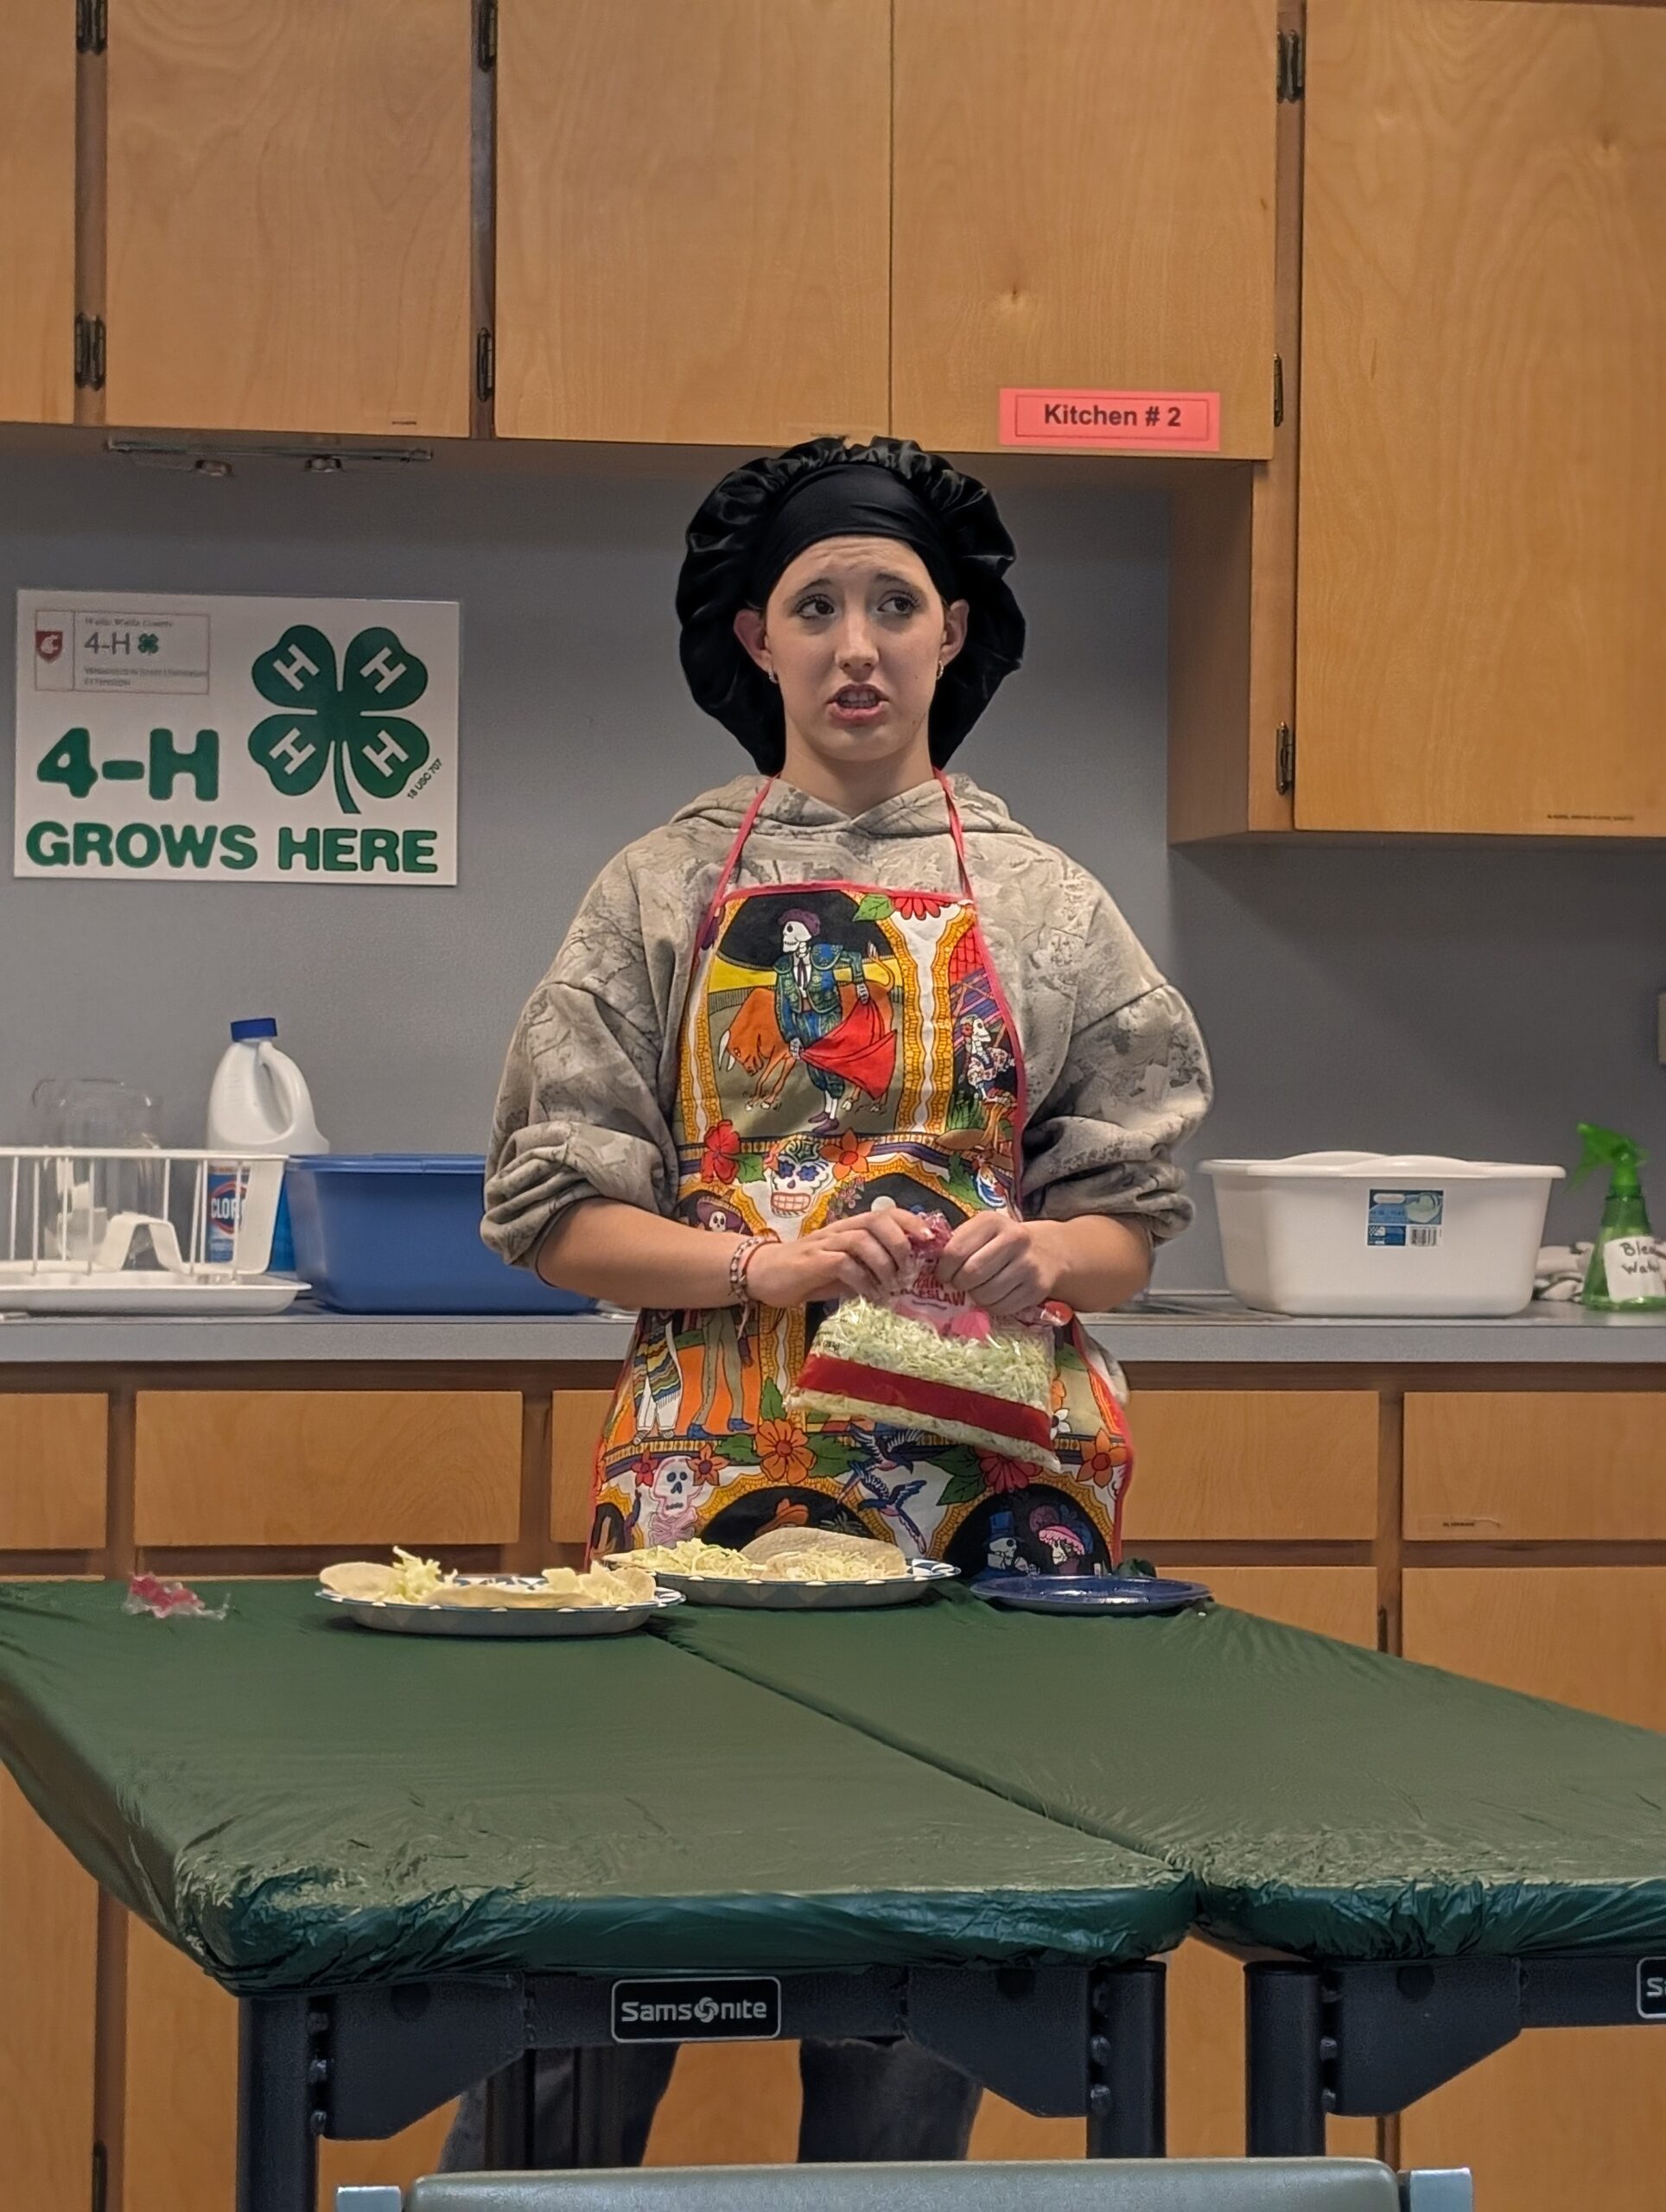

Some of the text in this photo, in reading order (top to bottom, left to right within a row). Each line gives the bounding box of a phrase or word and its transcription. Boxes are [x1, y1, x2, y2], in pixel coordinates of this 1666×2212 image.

[1044, 403, 1181, 427] Kitchen # 2
[84, 632, 130, 655] 4-H
[273, 644, 320, 692] H
[359, 646, 407, 694] H
[36, 727, 219, 802] 4-H
[269, 728, 316, 775] H
[362, 729, 409, 778] H
[407, 758, 442, 799] 18 USC 707
[26, 820, 438, 874] GROWS HERE
[621, 1996, 767, 2024] Samsonite
